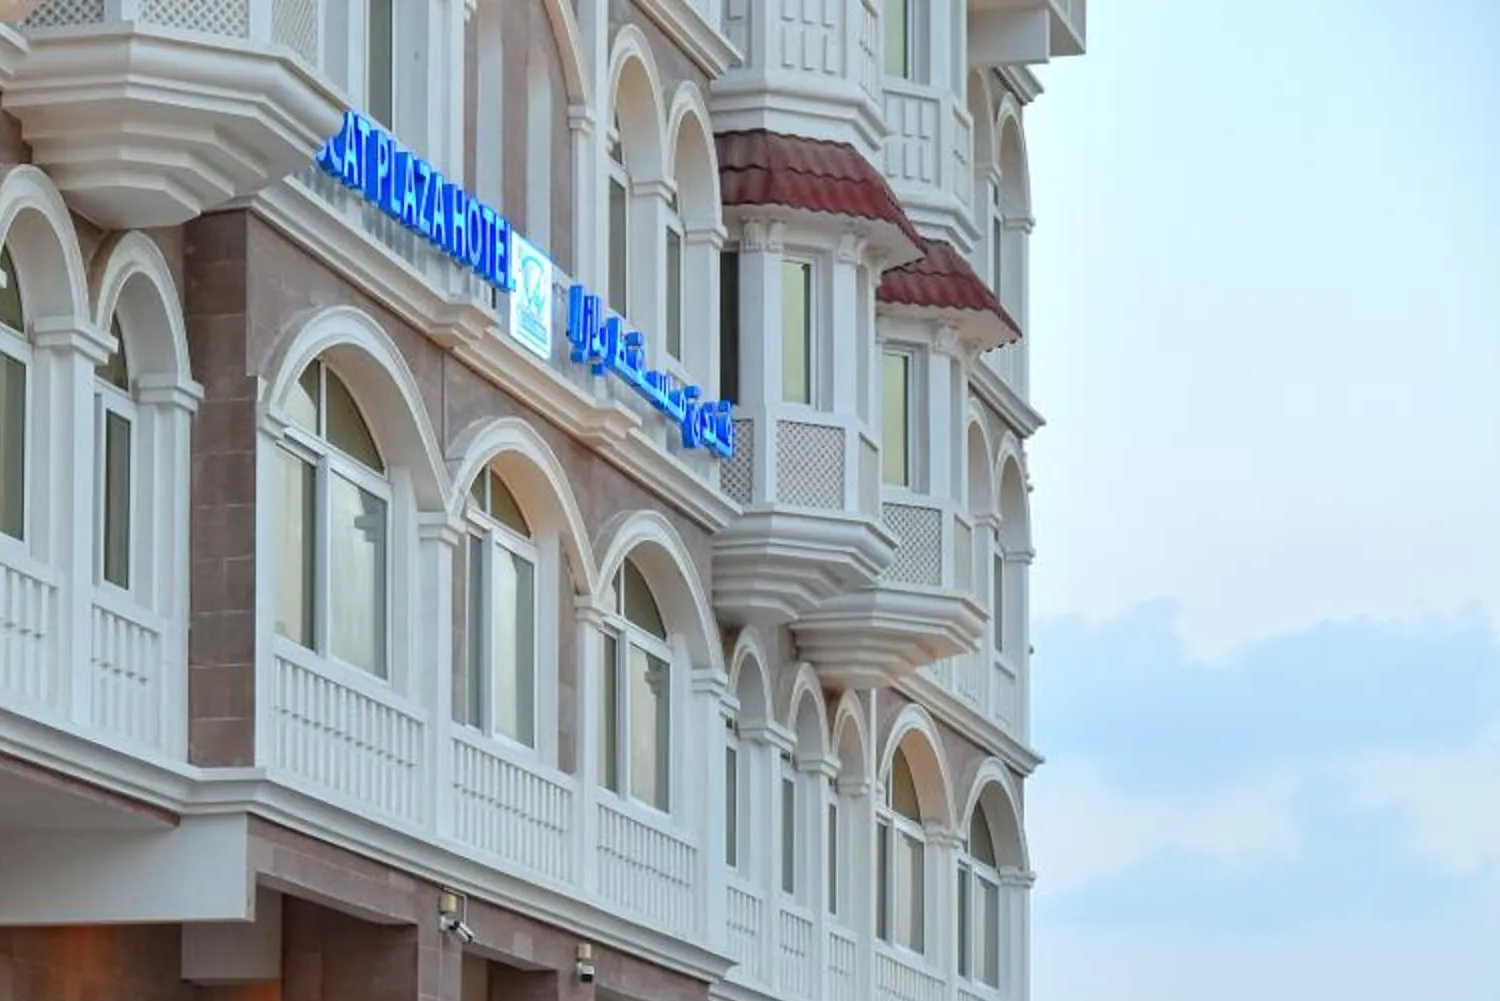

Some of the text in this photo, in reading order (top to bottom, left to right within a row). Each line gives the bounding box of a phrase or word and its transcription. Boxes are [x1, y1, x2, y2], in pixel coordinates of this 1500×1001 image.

[373, 129, 447, 247] PLAZA
[450, 184, 516, 290] HOTEL
[683, 385, 735, 458] فندق
